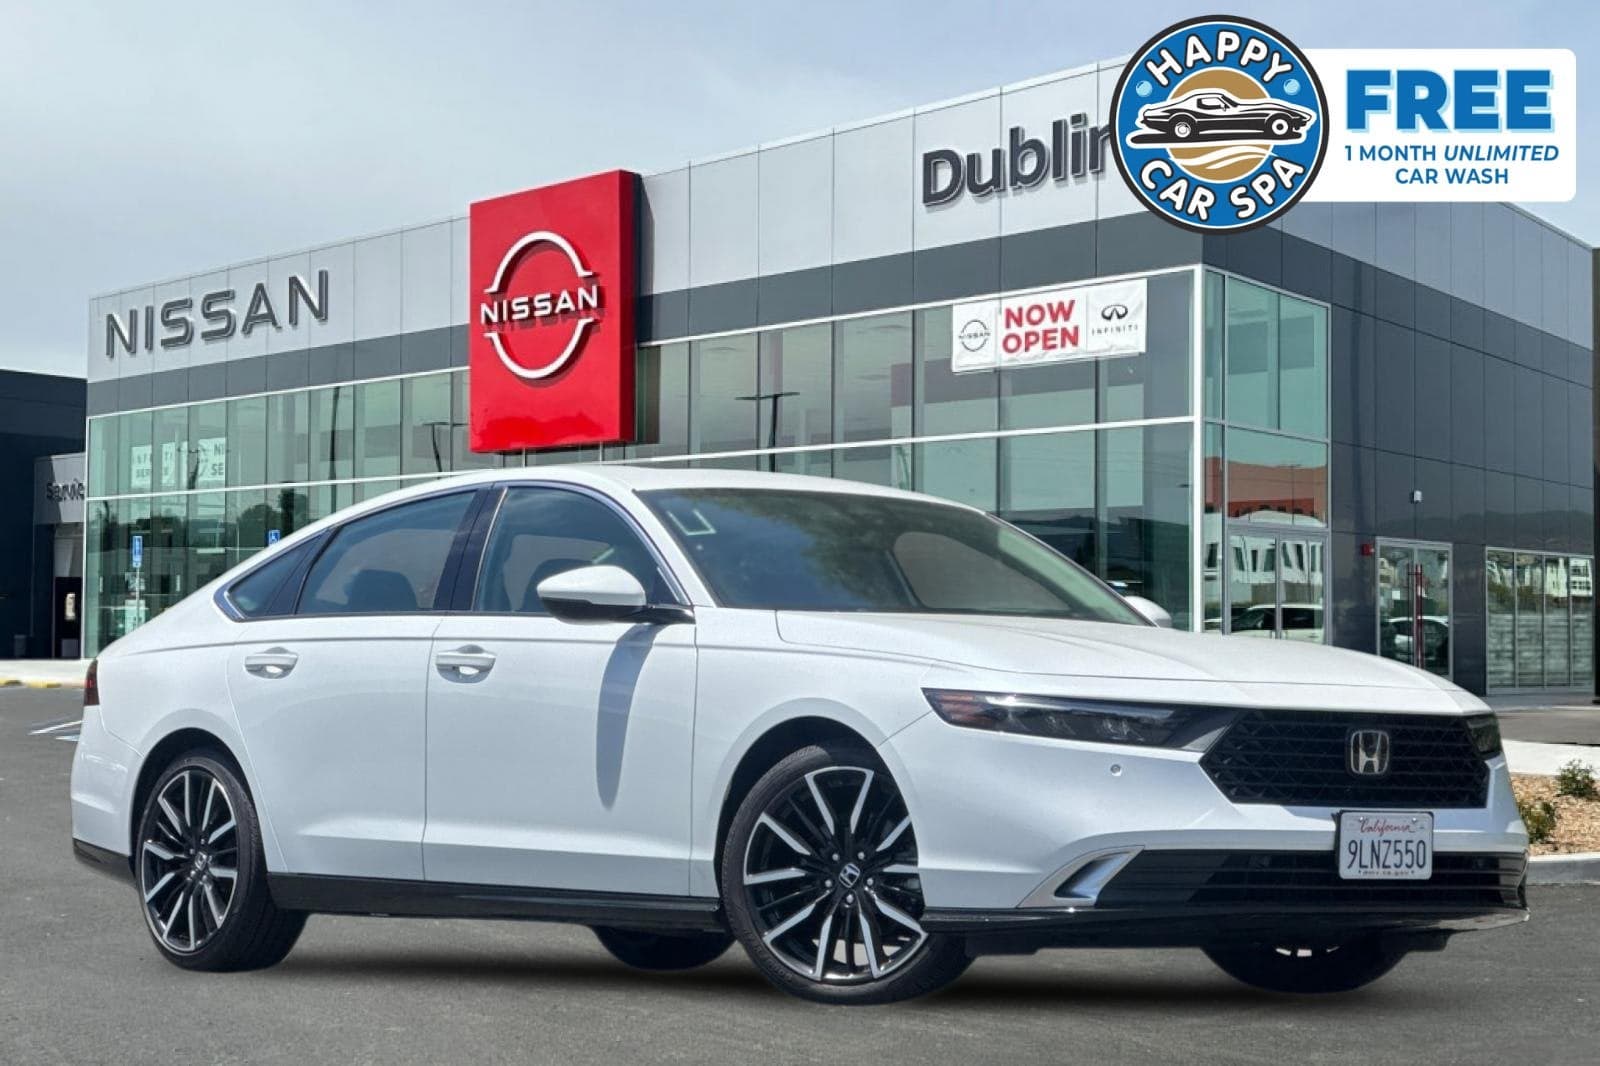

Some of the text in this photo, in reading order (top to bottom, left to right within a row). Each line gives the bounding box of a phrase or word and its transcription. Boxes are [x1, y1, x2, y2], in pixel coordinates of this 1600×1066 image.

[106, 269, 329, 359] NISSAN
[480, 285, 598, 325] NISSAN
[1005, 299, 1076, 329] NOW
[1002, 325, 1079, 354] OPEN
[1347, 839, 1426, 869] 9LNZ550
